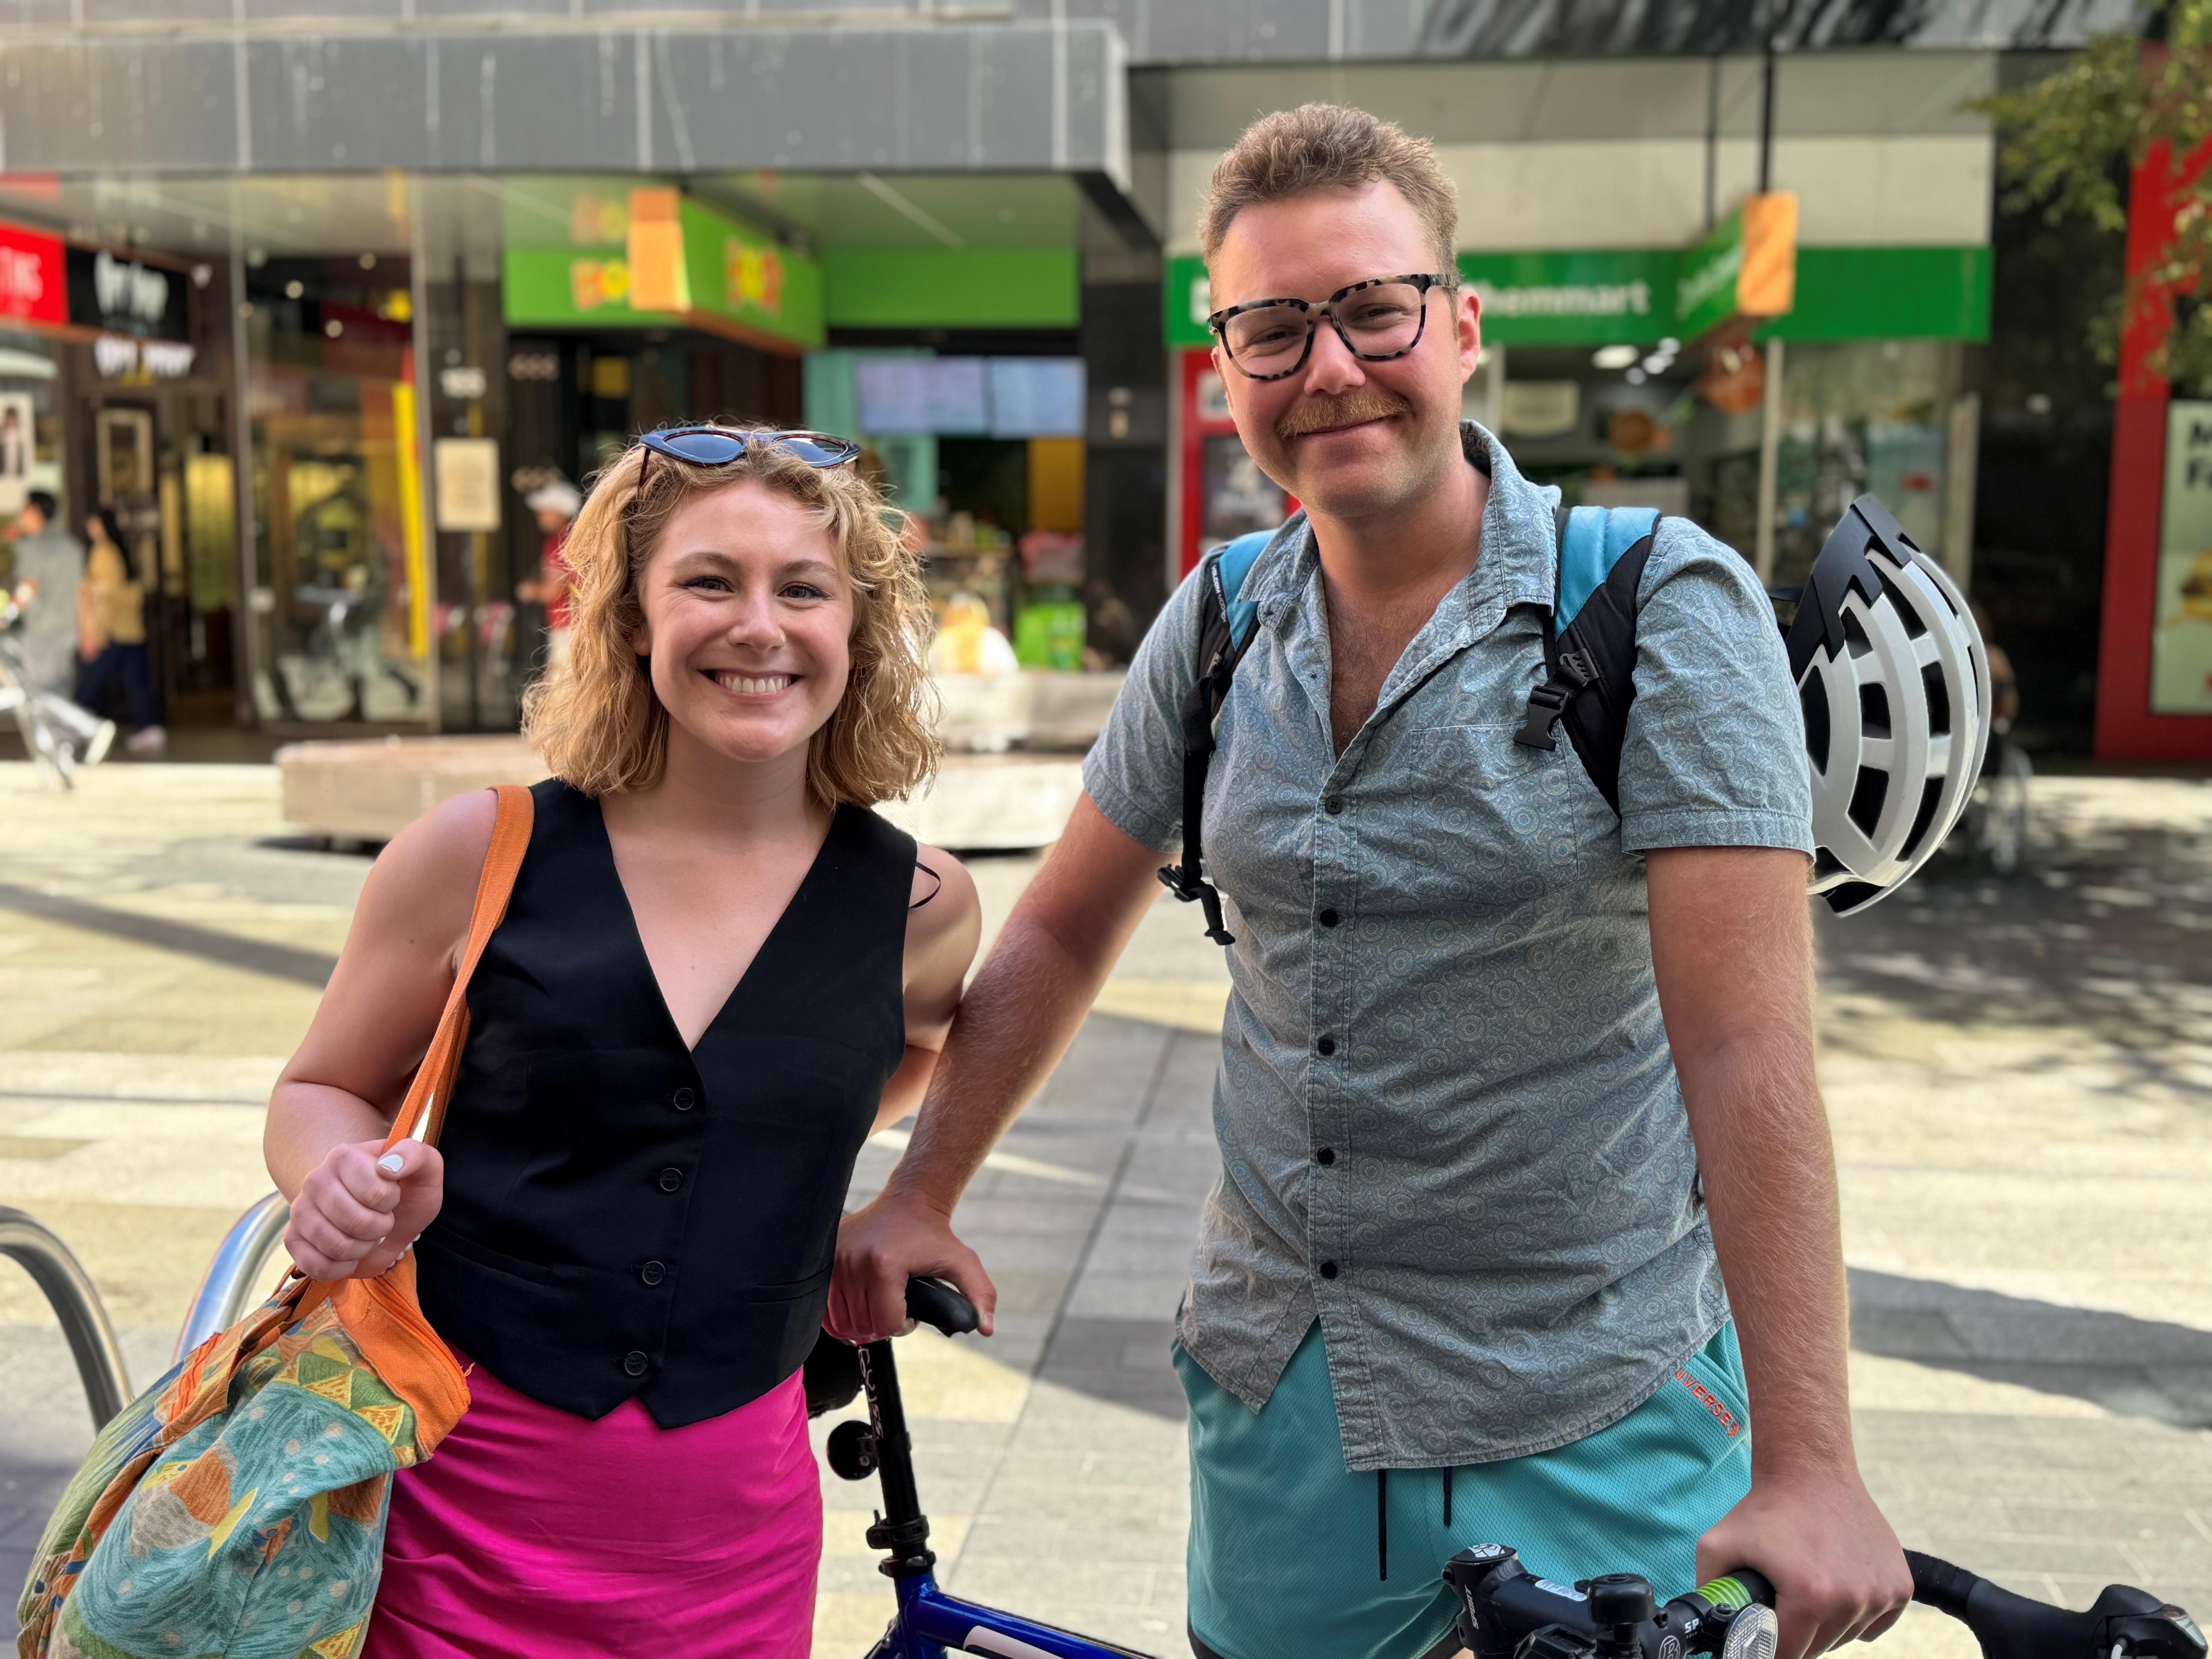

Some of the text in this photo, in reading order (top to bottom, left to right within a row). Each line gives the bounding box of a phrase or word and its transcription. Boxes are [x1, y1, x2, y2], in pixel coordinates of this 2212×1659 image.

[1479, 279, 1650, 316] hemmart
[1211, 565, 1221, 594] VOLCOM
[1675, 1369, 1733, 1428] NVERSE
